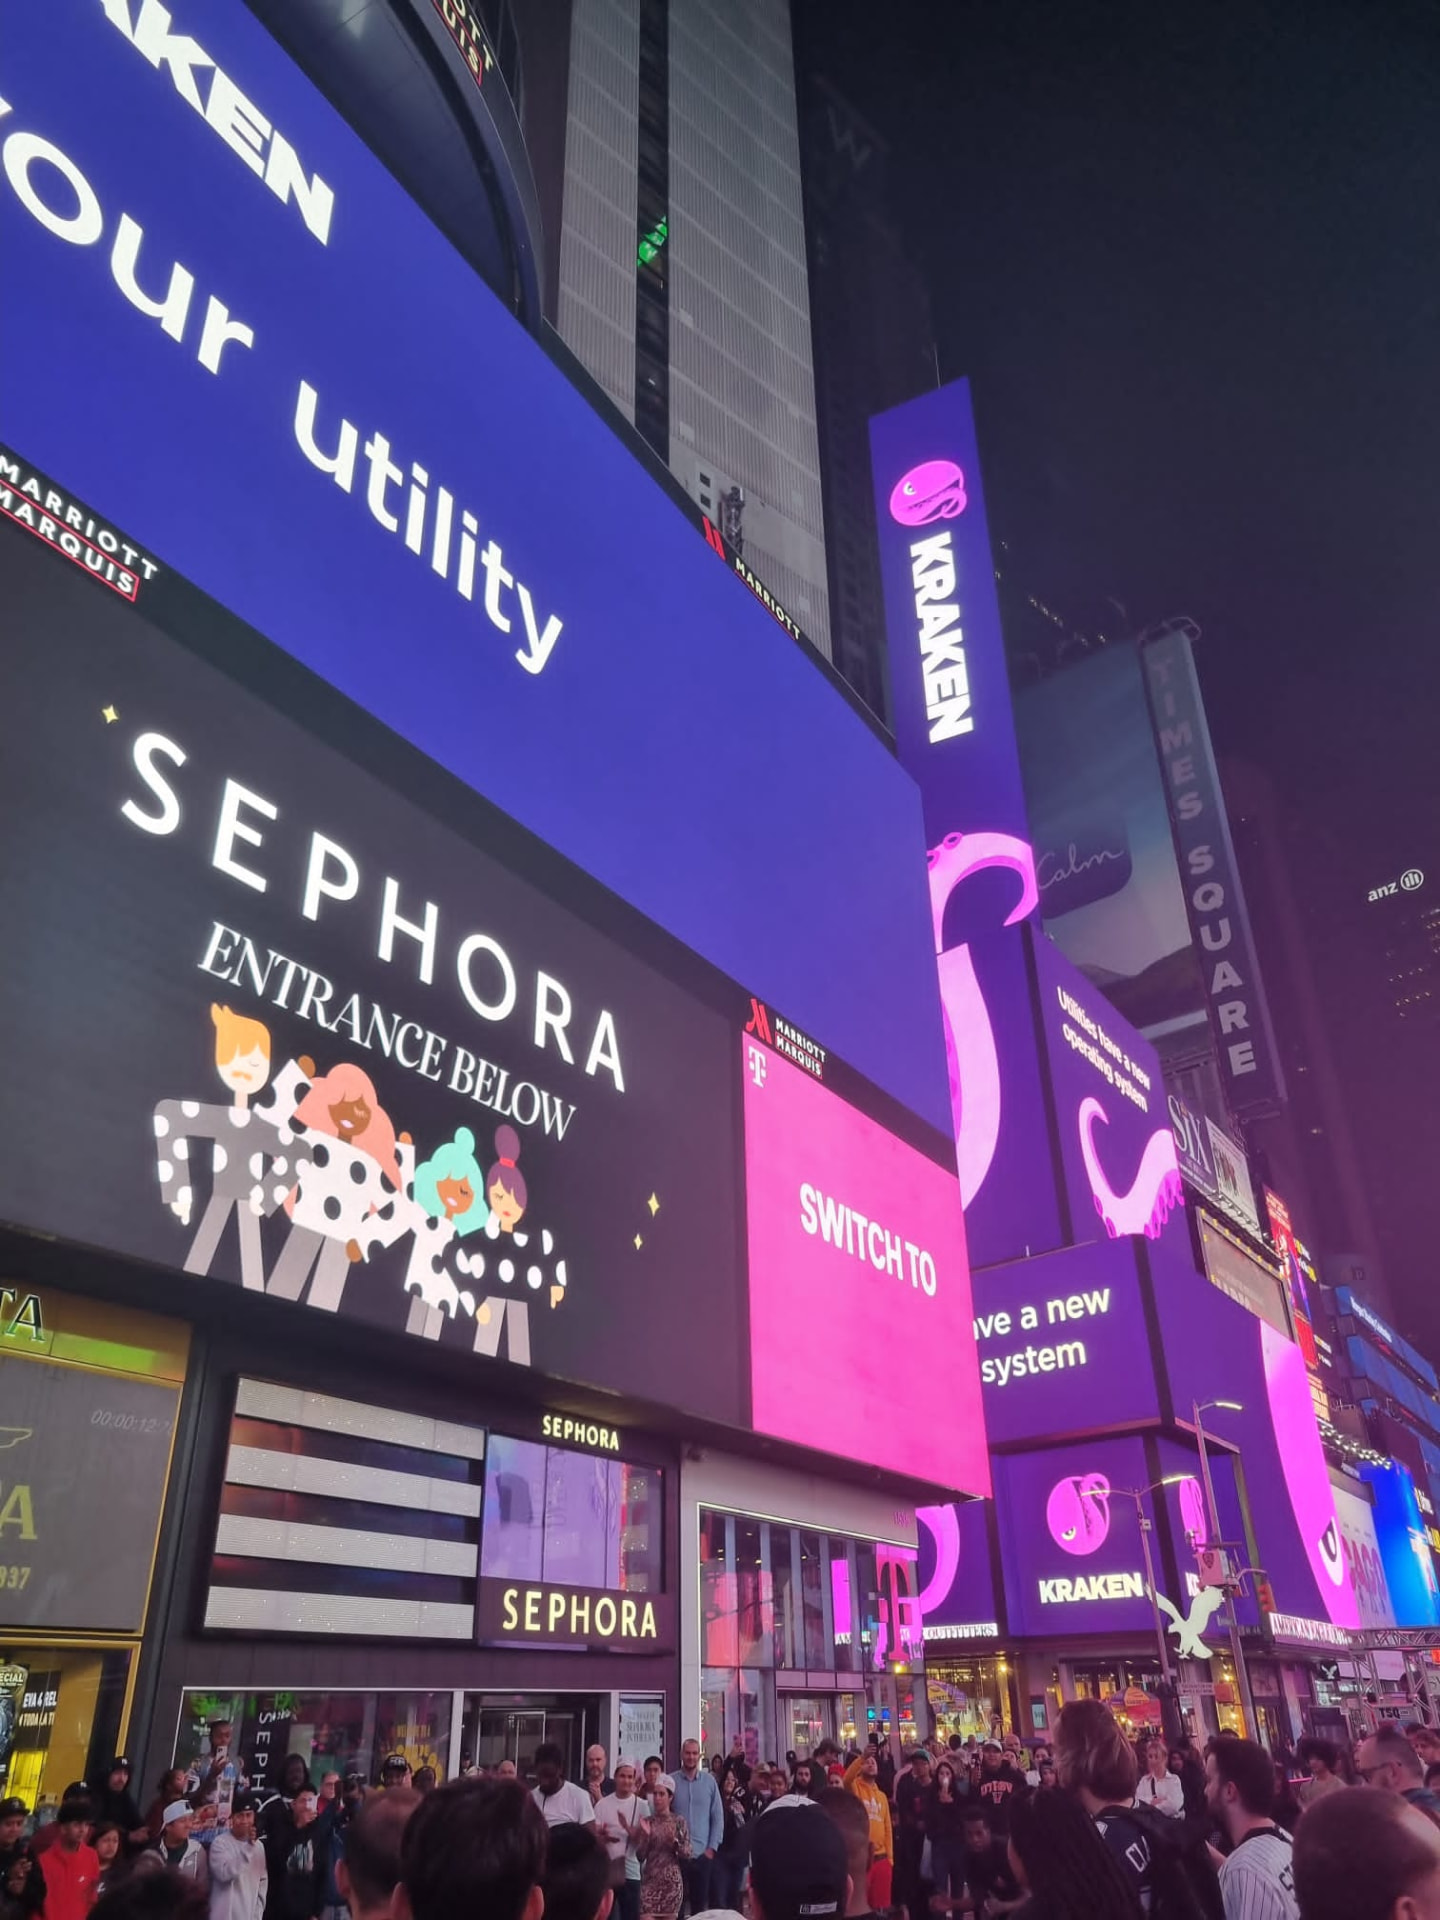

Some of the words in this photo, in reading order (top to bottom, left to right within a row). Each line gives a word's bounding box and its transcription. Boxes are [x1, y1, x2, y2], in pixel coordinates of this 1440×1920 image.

[0, 97, 254, 375] our
[294, 379, 563, 675] utility
[0, 454, 159, 581] MARRIOTT
[735, 557, 800, 640] MARRIOTT
[909, 530, 974, 744] KRAKEN
[1036, 842, 1125, 891] Calm
[1152, 655, 1203, 821] TIMES
[1187, 844, 1256, 1076] SQUARE
[120, 732, 626, 1094] SEPHORA
[1367, 881, 1399, 902] anz
[197, 921, 449, 1082] ENTRANCE
[446, 1046, 578, 1143] BELOW
[775, 1017, 826, 1063] MARRIOTT
[776, 1034, 822, 1076] MARQUIS
[800, 1182, 904, 1281] SWITCH
[904, 1240, 938, 1297] TO
[1020, 1304, 1039, 1331] a
[1046, 1287, 1112, 1324] new
[981, 1340, 1088, 1387] system
[542, 1414, 620, 1450] SEPHORA
[502, 1588, 658, 1639] SEPHORA
[1038, 1572, 1144, 1605] KRAKEN
